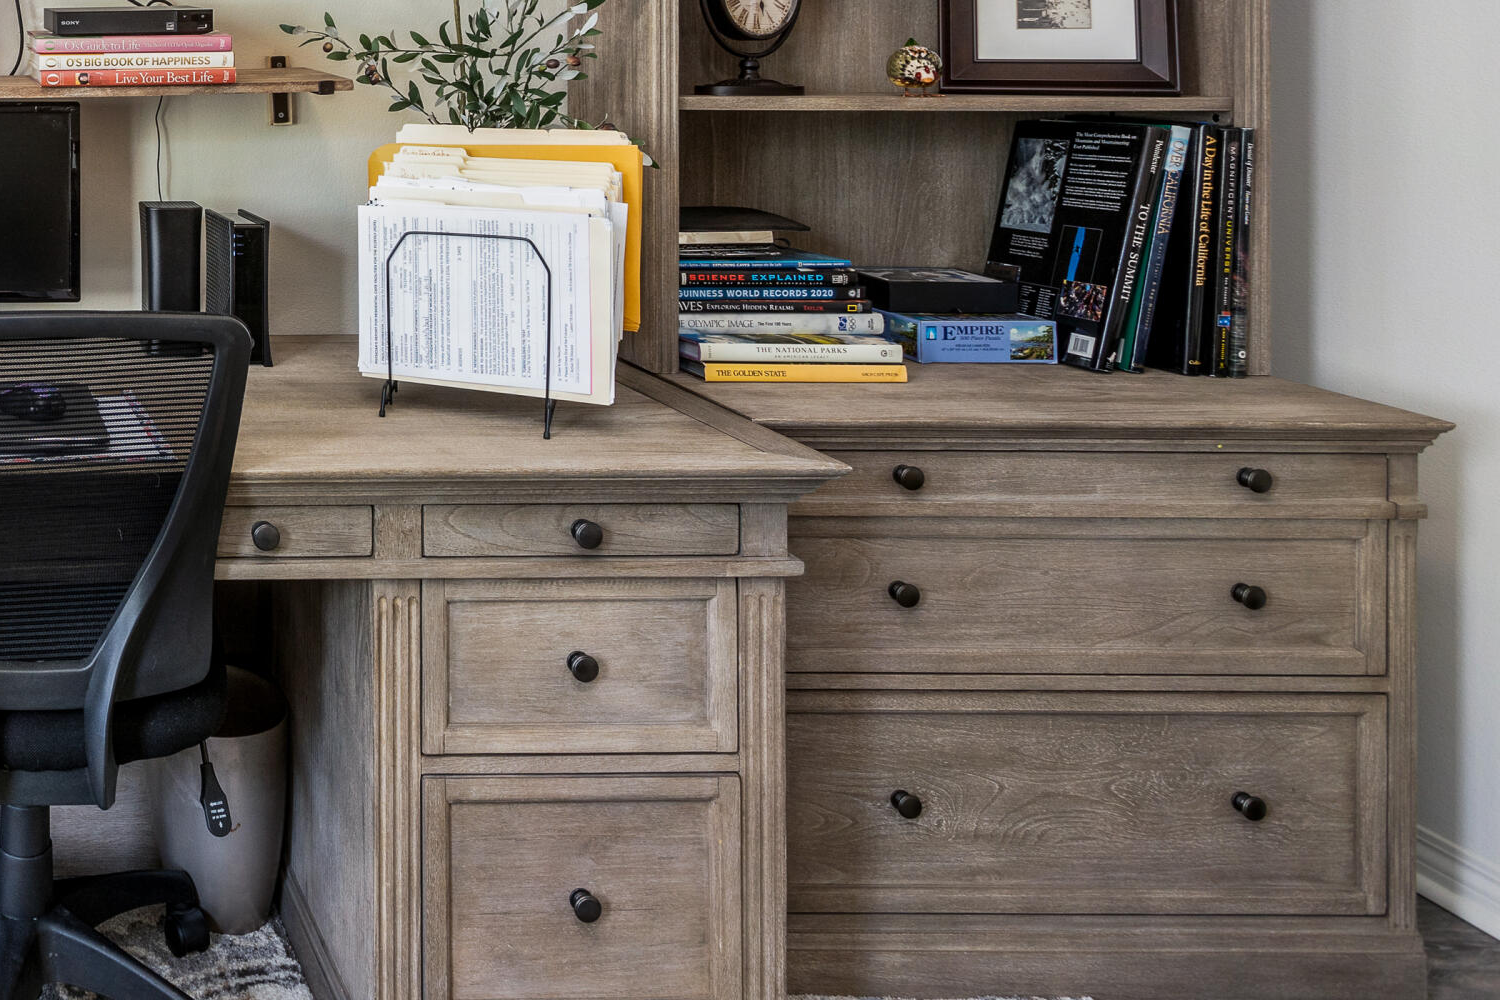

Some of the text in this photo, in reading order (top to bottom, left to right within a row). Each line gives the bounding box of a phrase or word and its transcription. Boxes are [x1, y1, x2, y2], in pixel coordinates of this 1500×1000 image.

[80, 40, 111, 50] Guide
[112, 41, 121, 49] to
[122, 39, 141, 50] Life
[66, 56, 211, 67] O'S BIG BOOK OF HAPPINESS
[115, 70, 214, 84] Live Your Best Life
[1150, 140, 1164, 174] Poindexter
[1157, 140, 1185, 235] OVER CALIFORNIA
[1195, 135, 1217, 287] A Day in the Life of California
[1223, 145, 1237, 274] MAGNIFICENT UNIVERSE
[1120, 204, 1151, 304] TO THE SUMMIT
[679, 289, 834, 297] GUINNESS WORLD RECORDS 2020
[679, 301, 703, 311] AVES
[688, 320, 724, 328] OLYMPIC
[728, 320, 754, 328] IMAGE
[942, 325, 1004, 341] EMPIRE
